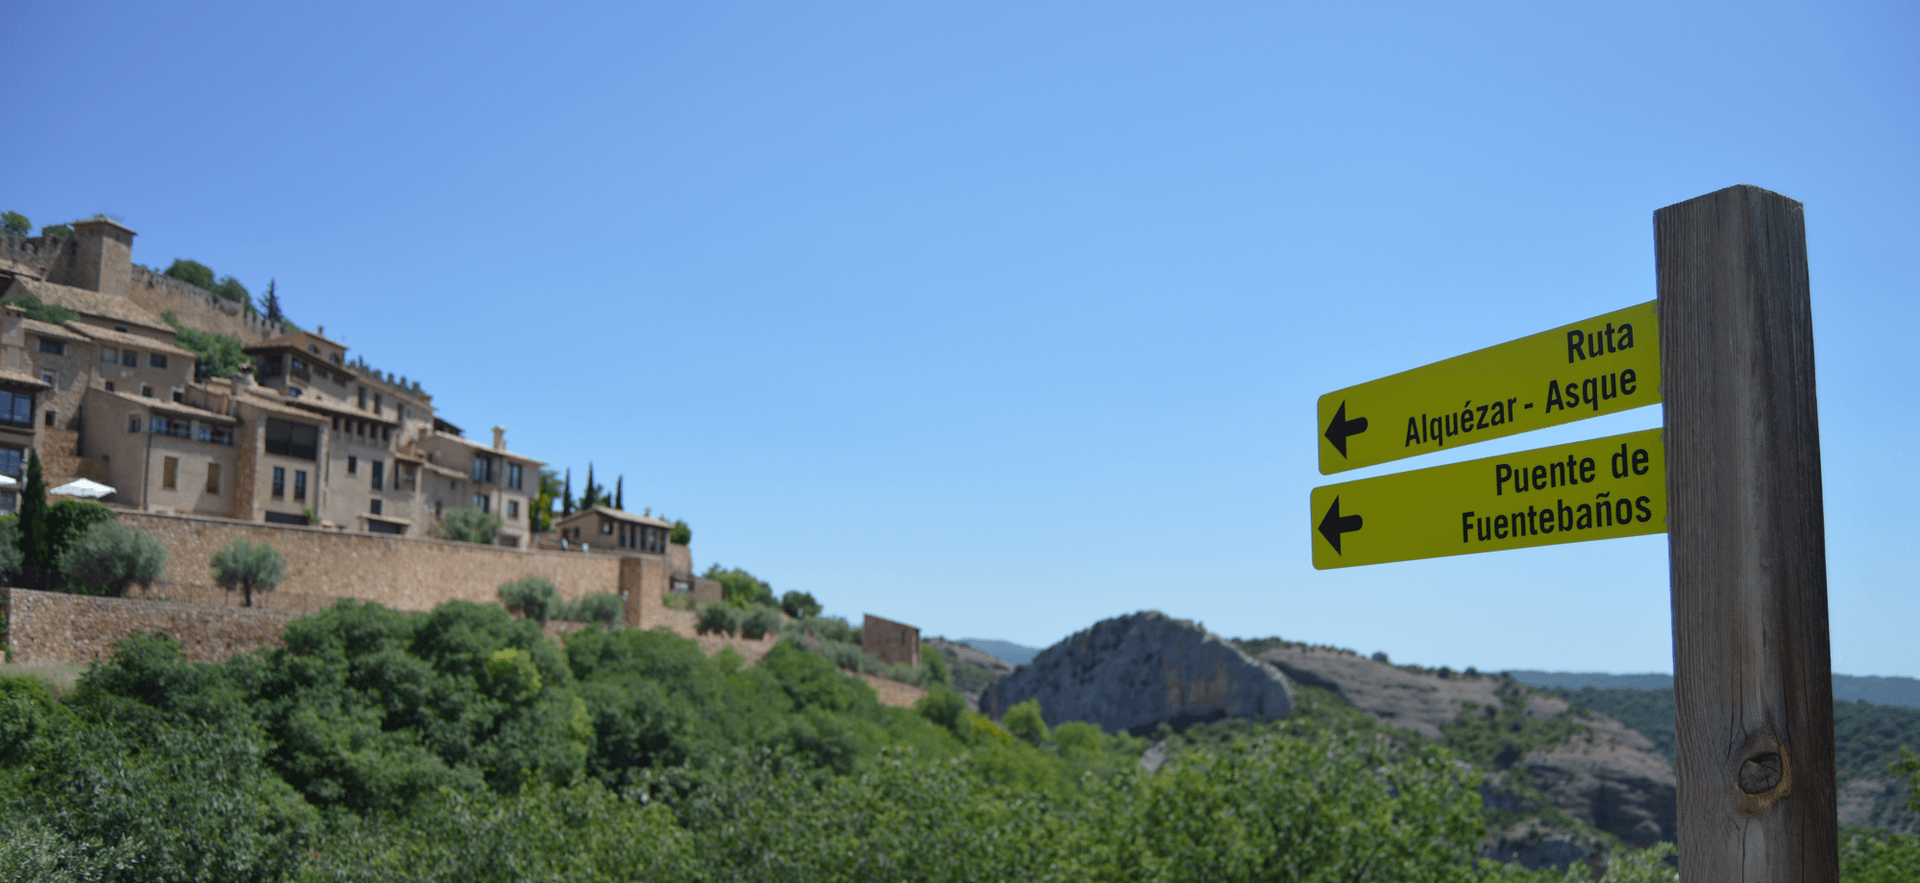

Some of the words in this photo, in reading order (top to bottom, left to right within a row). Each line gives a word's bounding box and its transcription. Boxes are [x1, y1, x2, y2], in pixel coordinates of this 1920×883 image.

[1566, 322, 1635, 364] Ruta
[1404, 396, 1518, 449] Alquézar
[1523, 401, 1534, 411] -
[1544, 367, 1638, 415] Asque
[1494, 453, 1597, 497] Puente
[1610, 443, 1650, 480] de
[1461, 491, 1653, 544] Fuentebaños
